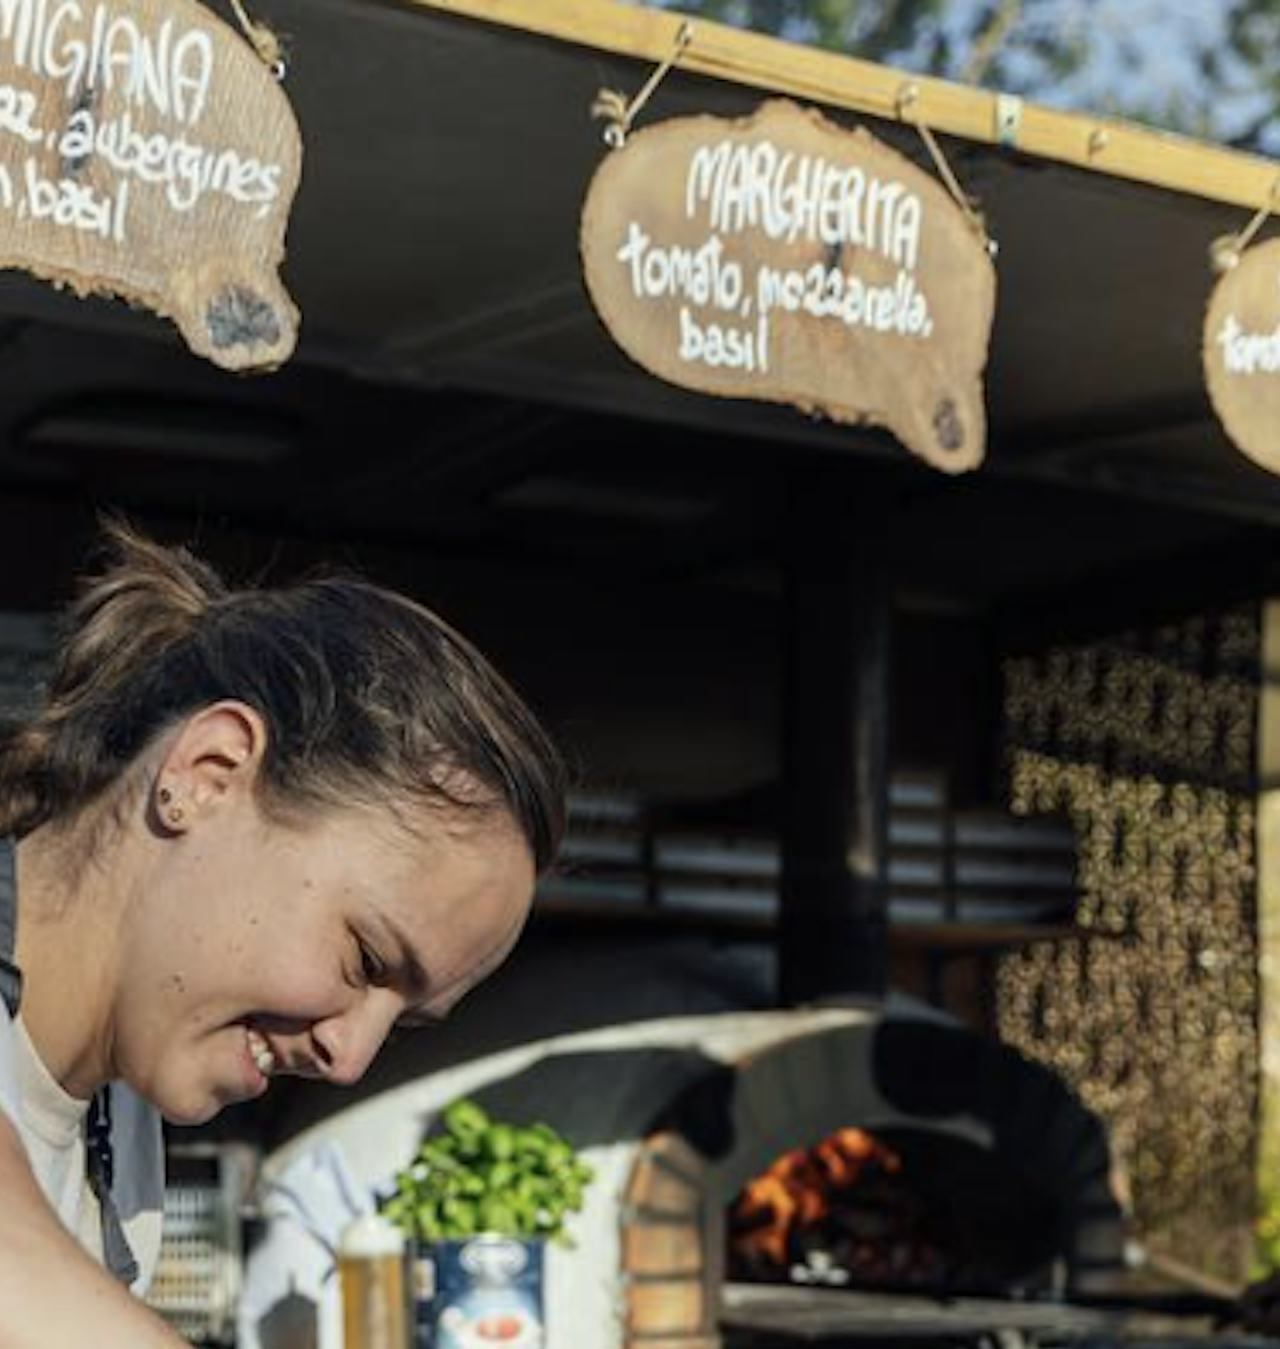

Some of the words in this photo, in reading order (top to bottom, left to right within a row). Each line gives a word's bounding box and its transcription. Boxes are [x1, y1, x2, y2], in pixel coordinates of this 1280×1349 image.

[686, 140, 922, 268] MARGHERITA
[618, 222, 751, 317] tomato,
[679, 306, 768, 372] basil
